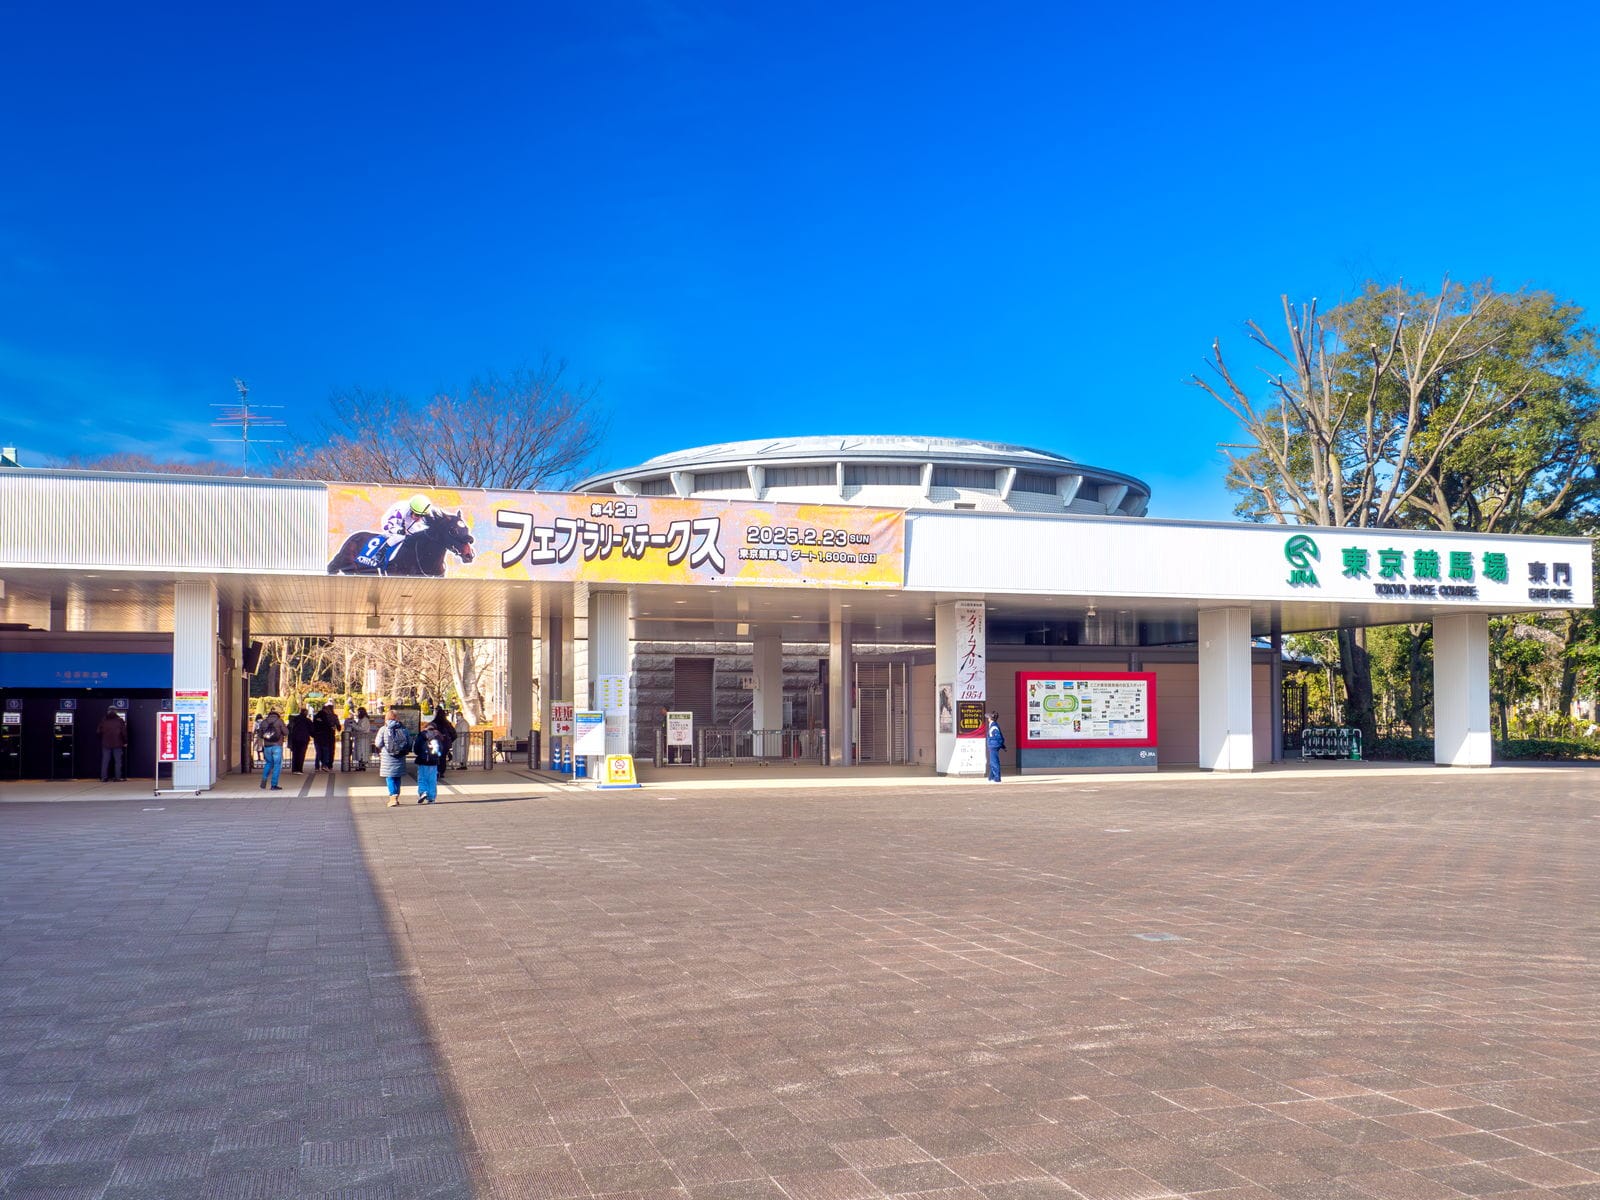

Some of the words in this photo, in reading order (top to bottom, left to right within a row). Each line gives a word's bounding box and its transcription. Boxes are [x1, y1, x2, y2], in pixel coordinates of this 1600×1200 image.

[591, 501, 637, 518] 第42回
[496, 509, 725, 574] フェブラリーステークス
[747, 526, 847, 547] 2025.2.23
[849, 534, 870, 544] SUN
[738, 548, 788, 561] 東京競馬場
[1341, 546, 1506, 582] 東京競馬場
[1286, 569, 1318, 585] JRA
[1528, 561, 1570, 582] 東門
[1373, 583, 1406, 595] TOKYO
[1409, 584, 1436, 596] RACE
[1438, 585, 1477, 597] COURSE
[1528, 588, 1549, 600] EAST
[1550, 589, 1572, 600] GATE
[962, 614, 977, 684] タイムスリップ
